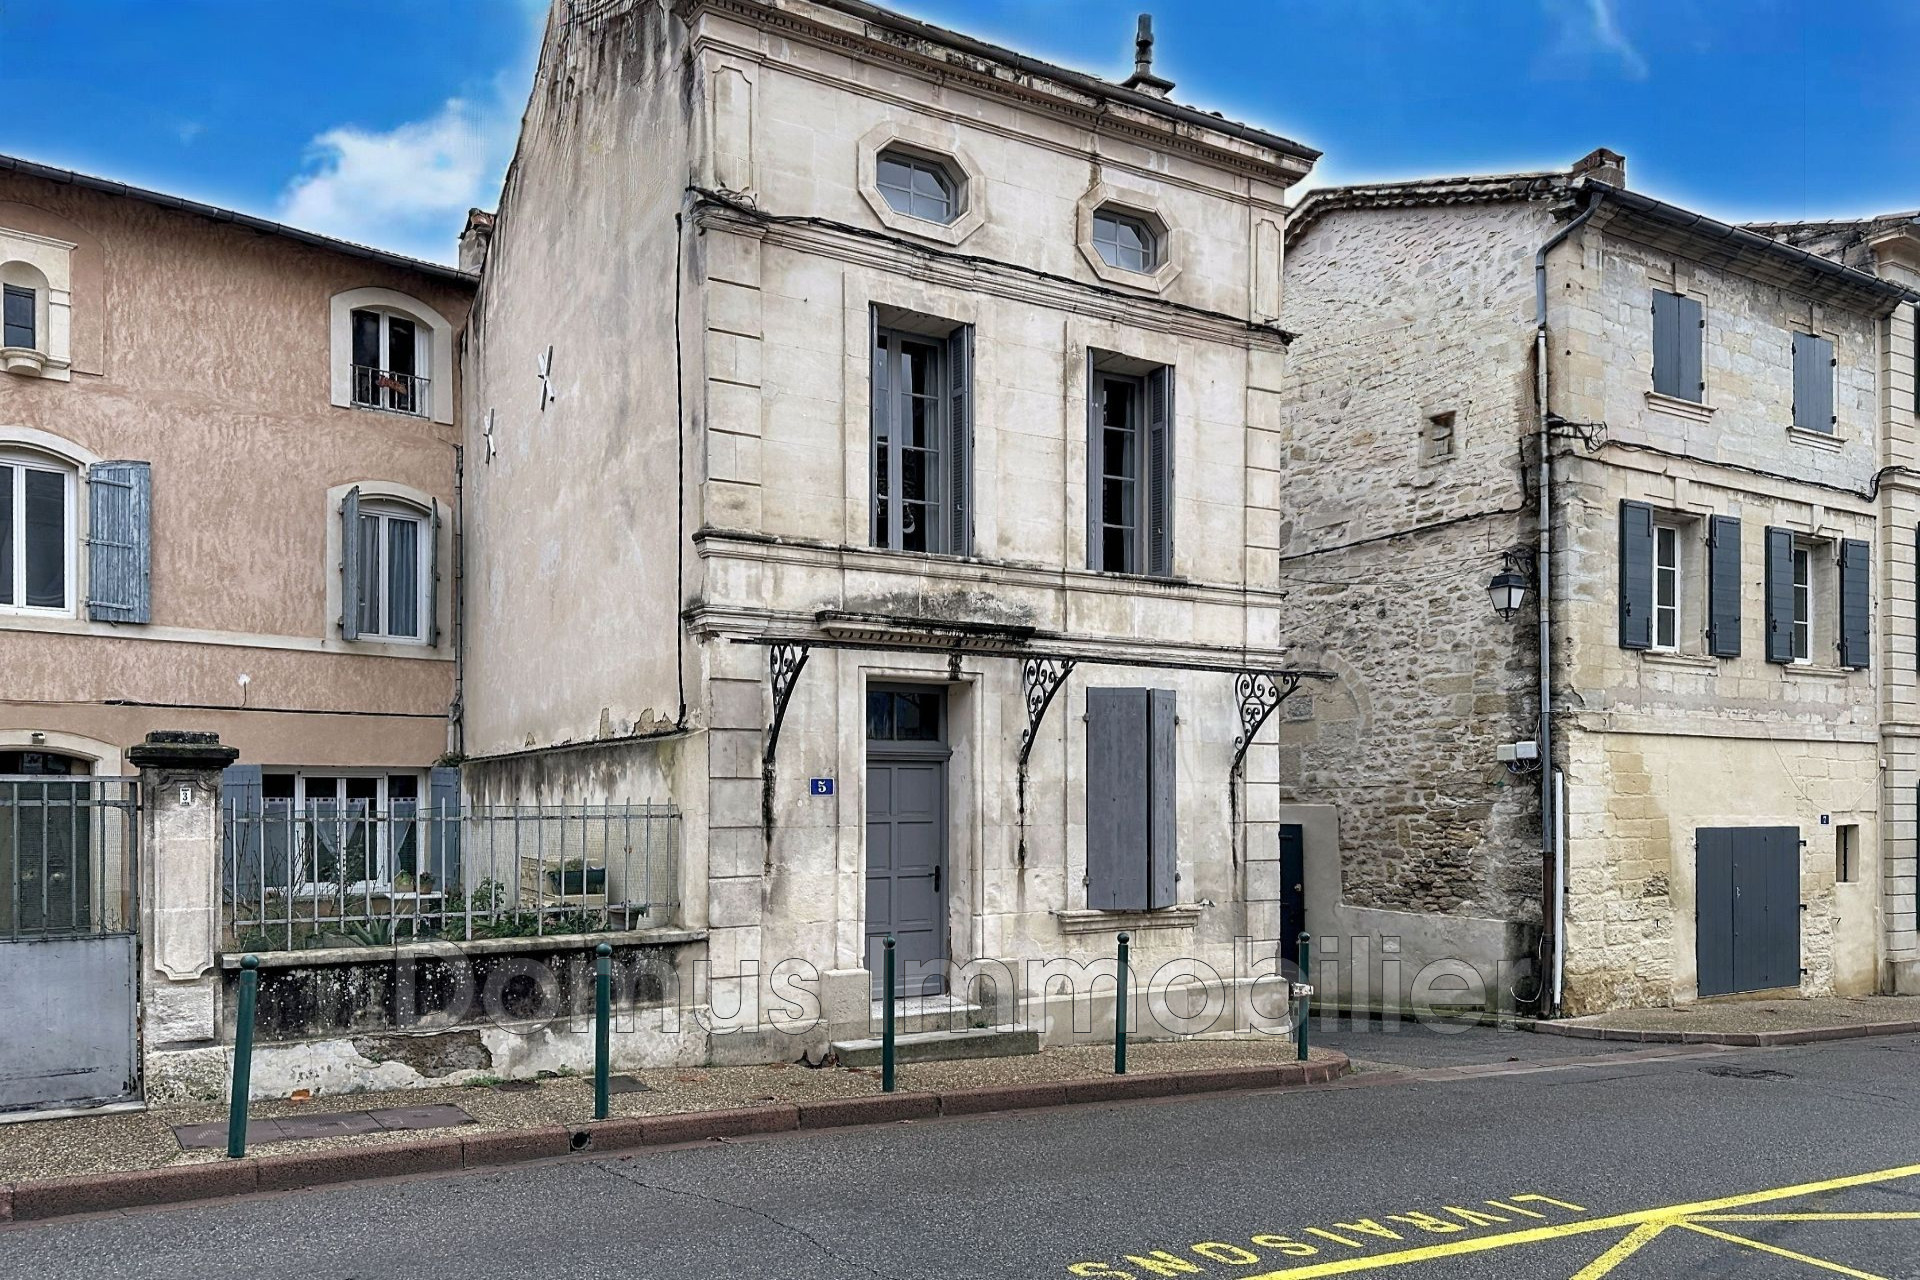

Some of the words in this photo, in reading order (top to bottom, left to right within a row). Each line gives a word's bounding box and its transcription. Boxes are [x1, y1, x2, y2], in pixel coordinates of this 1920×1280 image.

[817, 780, 827, 793] 5
[182, 791, 188, 801] 3
[1066, 1194, 1587, 1280] LIVRAISONS
